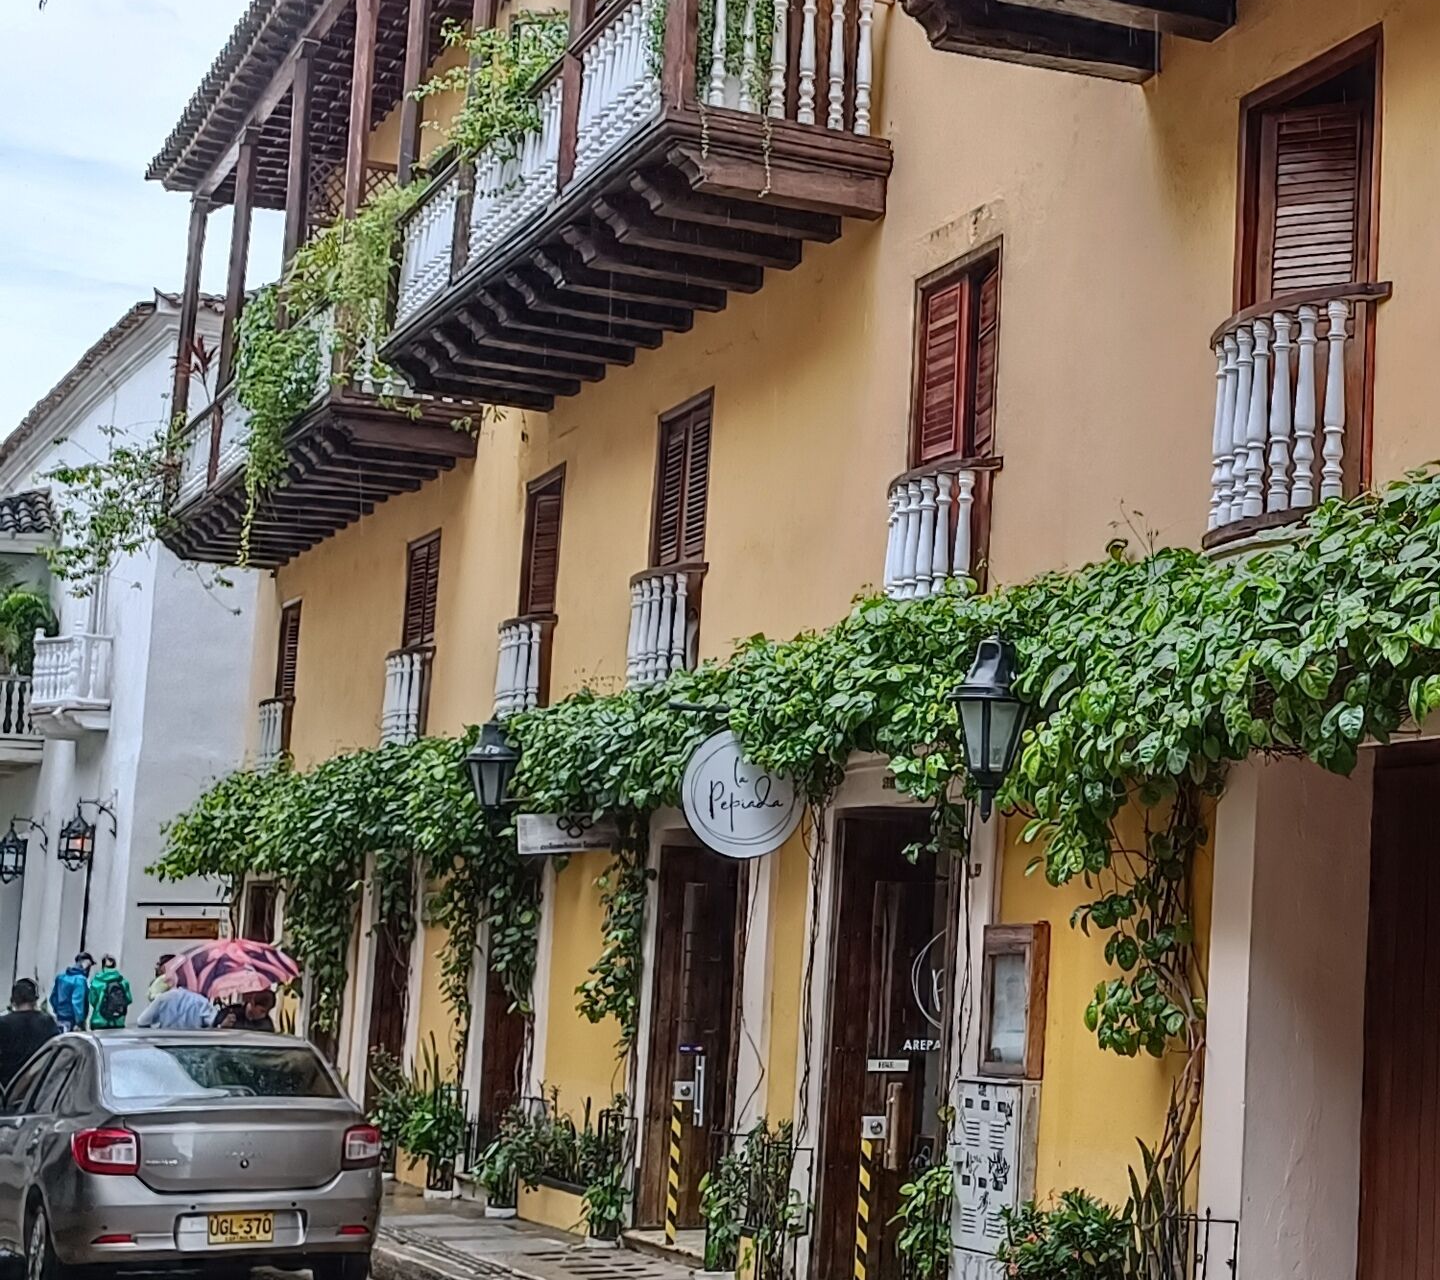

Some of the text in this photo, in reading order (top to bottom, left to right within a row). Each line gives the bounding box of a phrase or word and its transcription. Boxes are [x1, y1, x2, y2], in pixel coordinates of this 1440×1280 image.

[733, 756, 748, 789] la
[708, 775, 784, 832] Pepiada
[902, 1039, 942, 1051] AREPA
